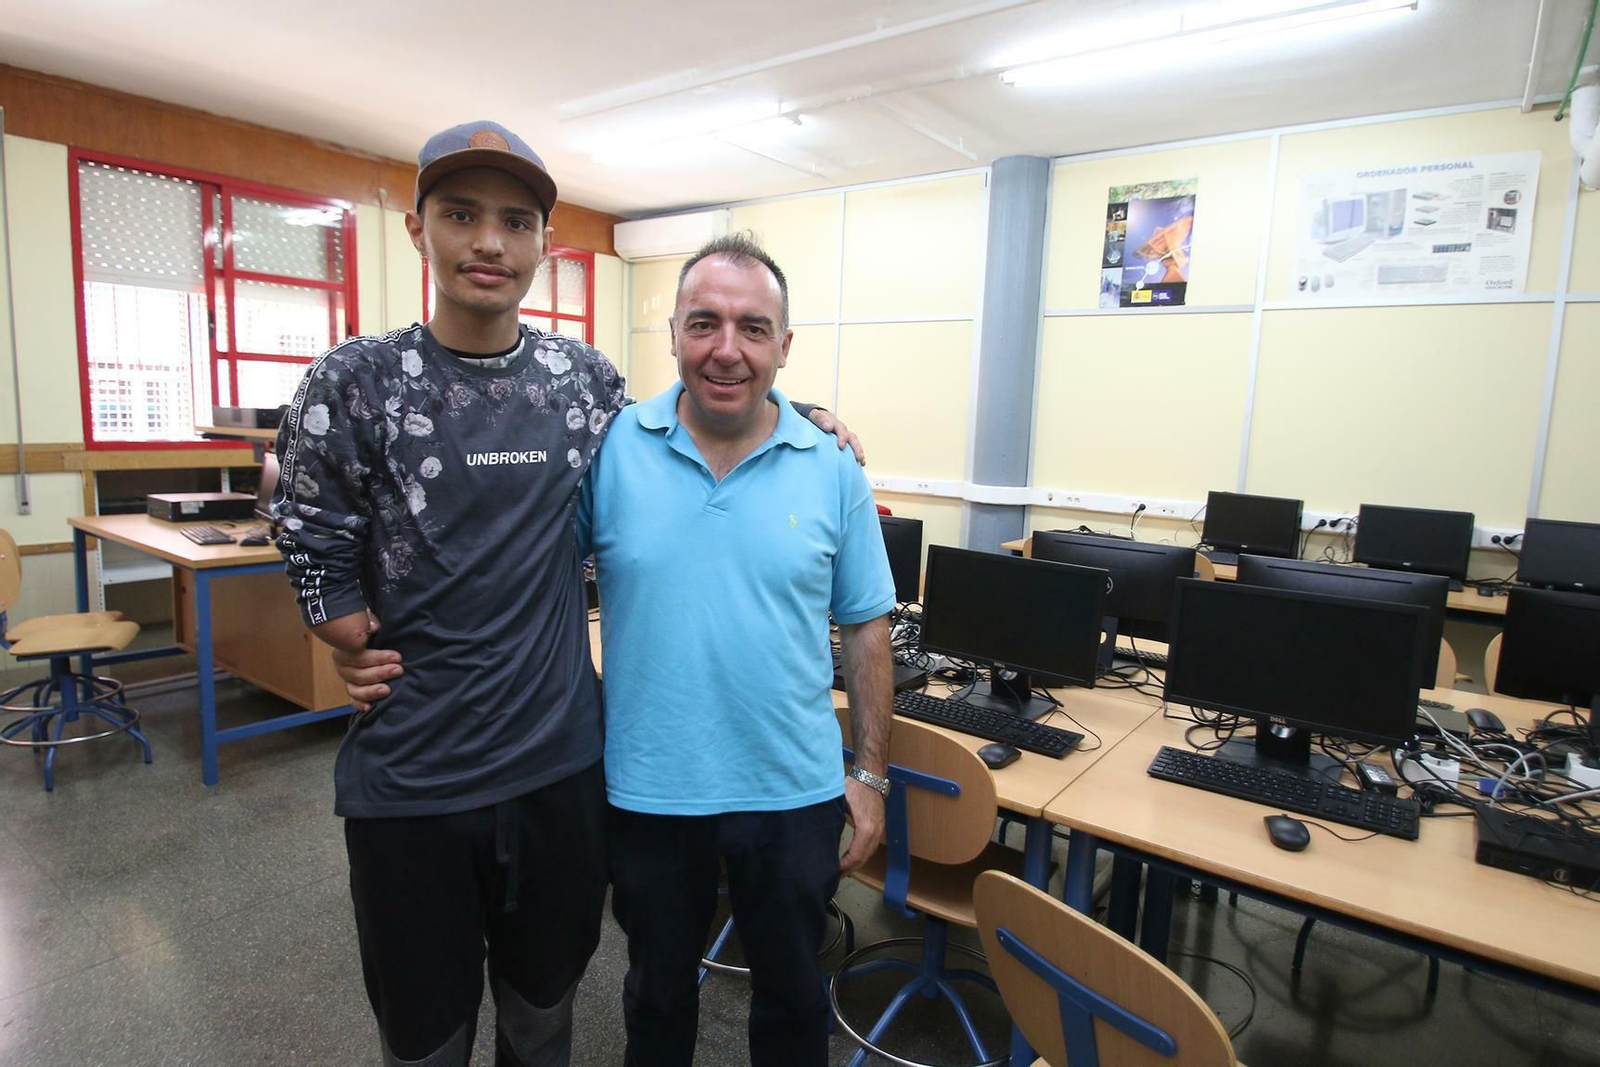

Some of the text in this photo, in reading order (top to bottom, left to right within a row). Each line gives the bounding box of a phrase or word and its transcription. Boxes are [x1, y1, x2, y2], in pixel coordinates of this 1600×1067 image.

[1356, 161, 1475, 179] ORDENADOR PERSONAL
[466, 450, 547, 466] UNBROKEN
